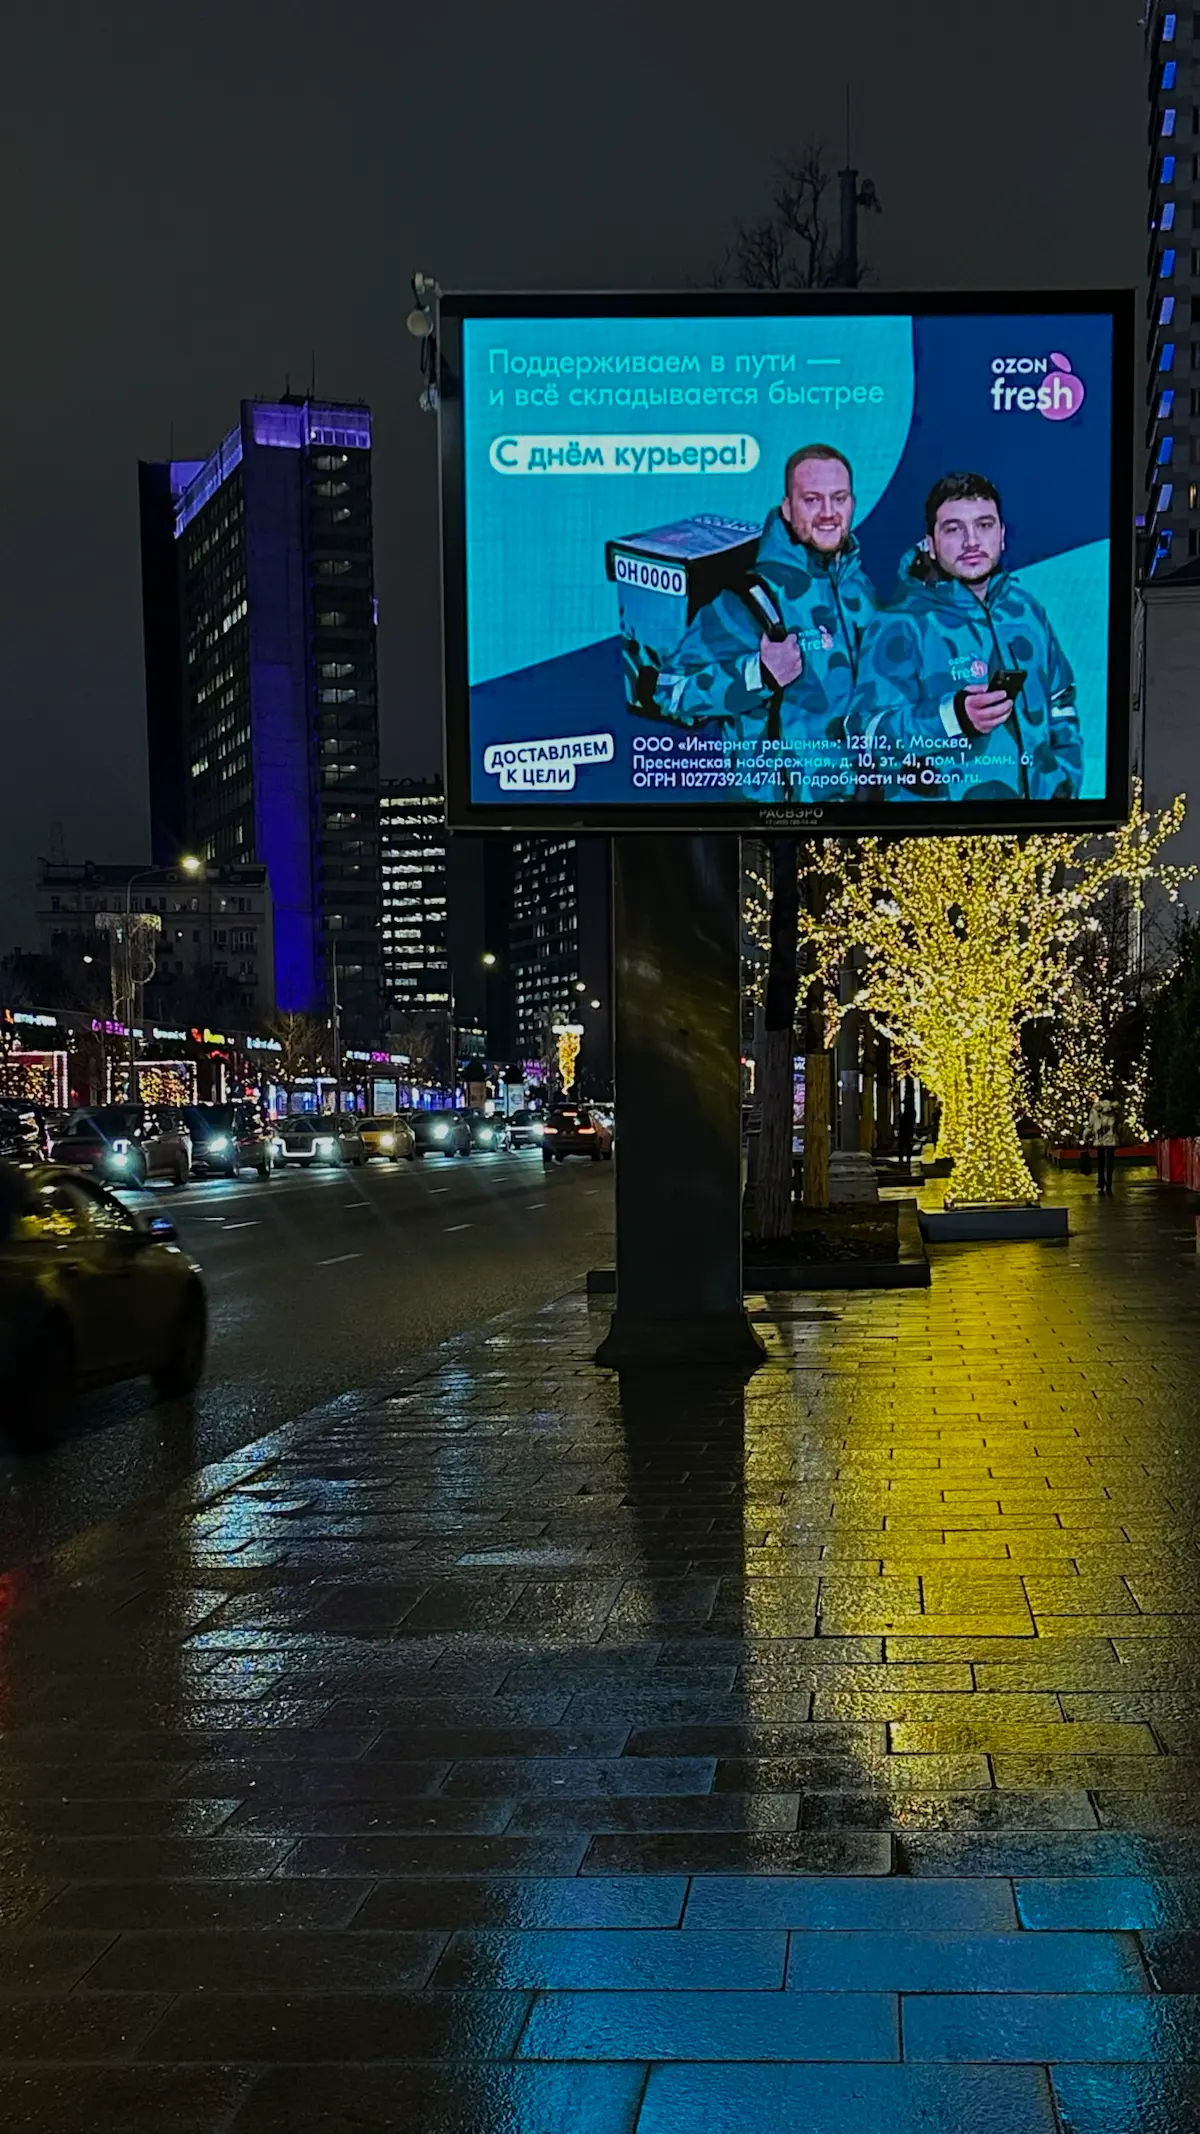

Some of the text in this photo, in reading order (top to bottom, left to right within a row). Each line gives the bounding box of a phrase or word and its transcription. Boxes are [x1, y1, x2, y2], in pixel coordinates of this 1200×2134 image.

[489, 349, 700, 380] Поддерживаем
[711, 355, 725, 373] в
[735, 352, 796, 378] пути
[991, 357, 1048, 374] OZON
[488, 380, 884, 410] и всё складывается быстрее
[990, 376, 1073, 411] fresh
[494, 438, 747, 471] С днём курьера!
[491, 740, 608, 769] ДОСТАВЛЯЕМ
[632, 735, 973, 754] ООО «Интернет решения»: 123112, г. Москва,
[632, 754, 732, 772] Пресненская
[736, 754, 836, 771] набережная,
[839, 757, 853, 769] д.
[857, 752, 876, 770] 10,
[879, 756, 898, 768] эт.
[901, 752, 921, 769] 41,
[974, 755, 1016, 766] комн.
[1020, 751, 1034, 767] 6;
[506, 768, 570, 786] К ЦЕЛИ
[632, 771, 677, 788] ОГРН
[789, 770, 893, 788] Подробности
[896, 773, 917, 785] на
[758, 807, 824, 819] РАСВЭРО
